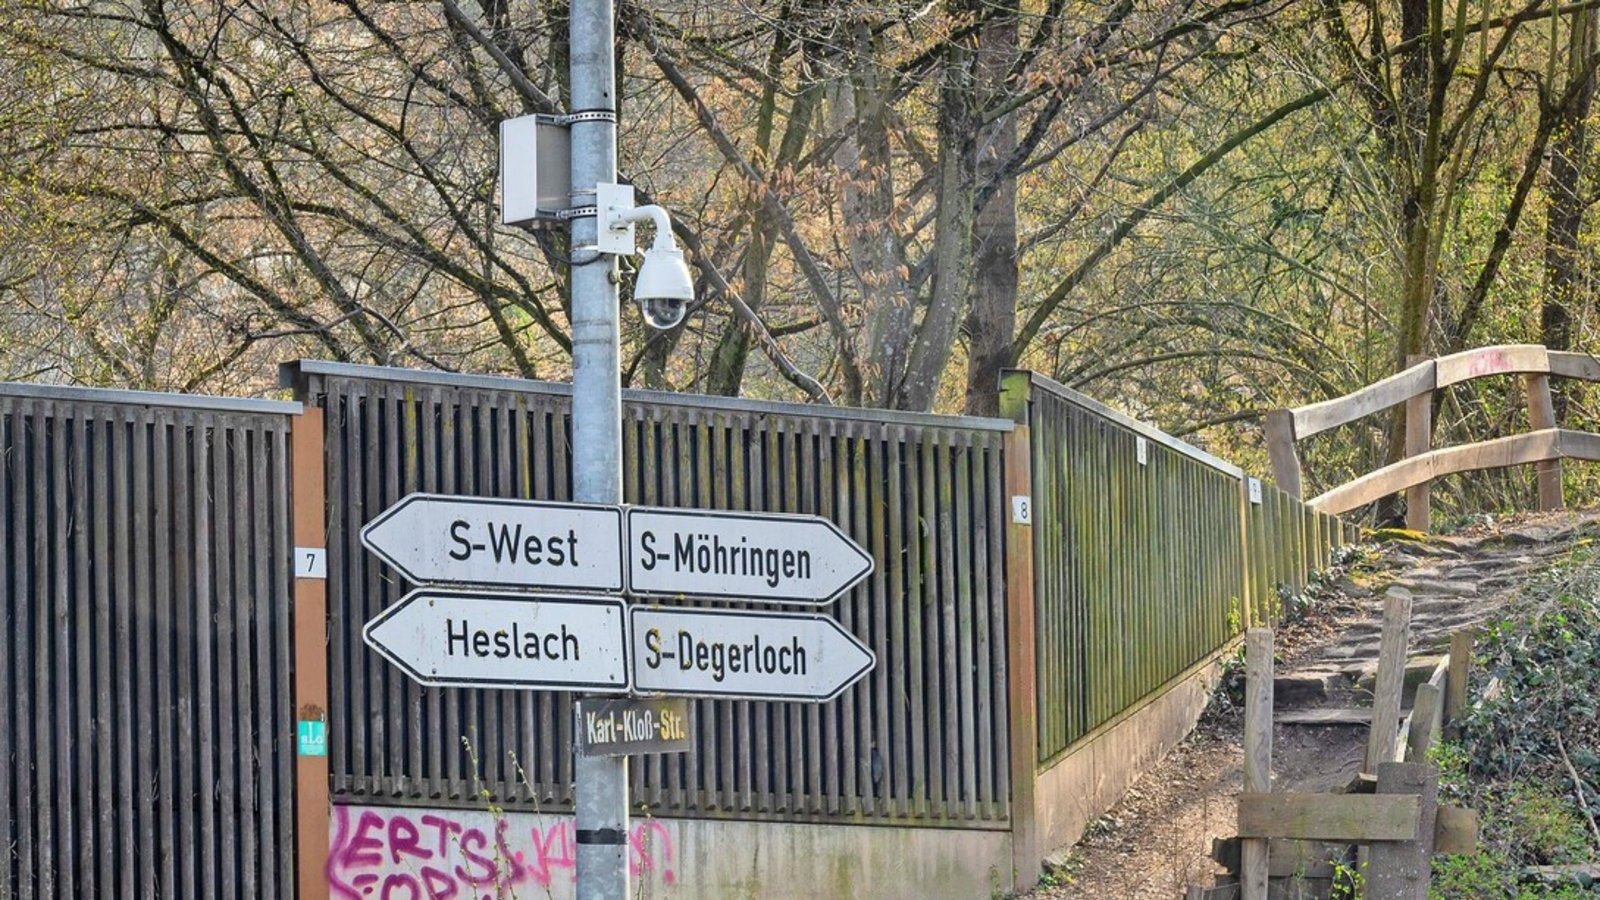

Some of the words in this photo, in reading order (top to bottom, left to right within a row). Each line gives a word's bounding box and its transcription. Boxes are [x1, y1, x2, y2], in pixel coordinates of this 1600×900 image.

[1020, 501, 1028, 519] 8
[306, 553, 315, 572] 7
[449, 520, 579, 567] S-West
[641, 530, 811, 588] S-Möhringen
[446, 618, 580, 661] Heslach
[645, 628, 807, 682] S-Degerloch
[586, 709, 685, 744] Karl-Kloß-Str.
